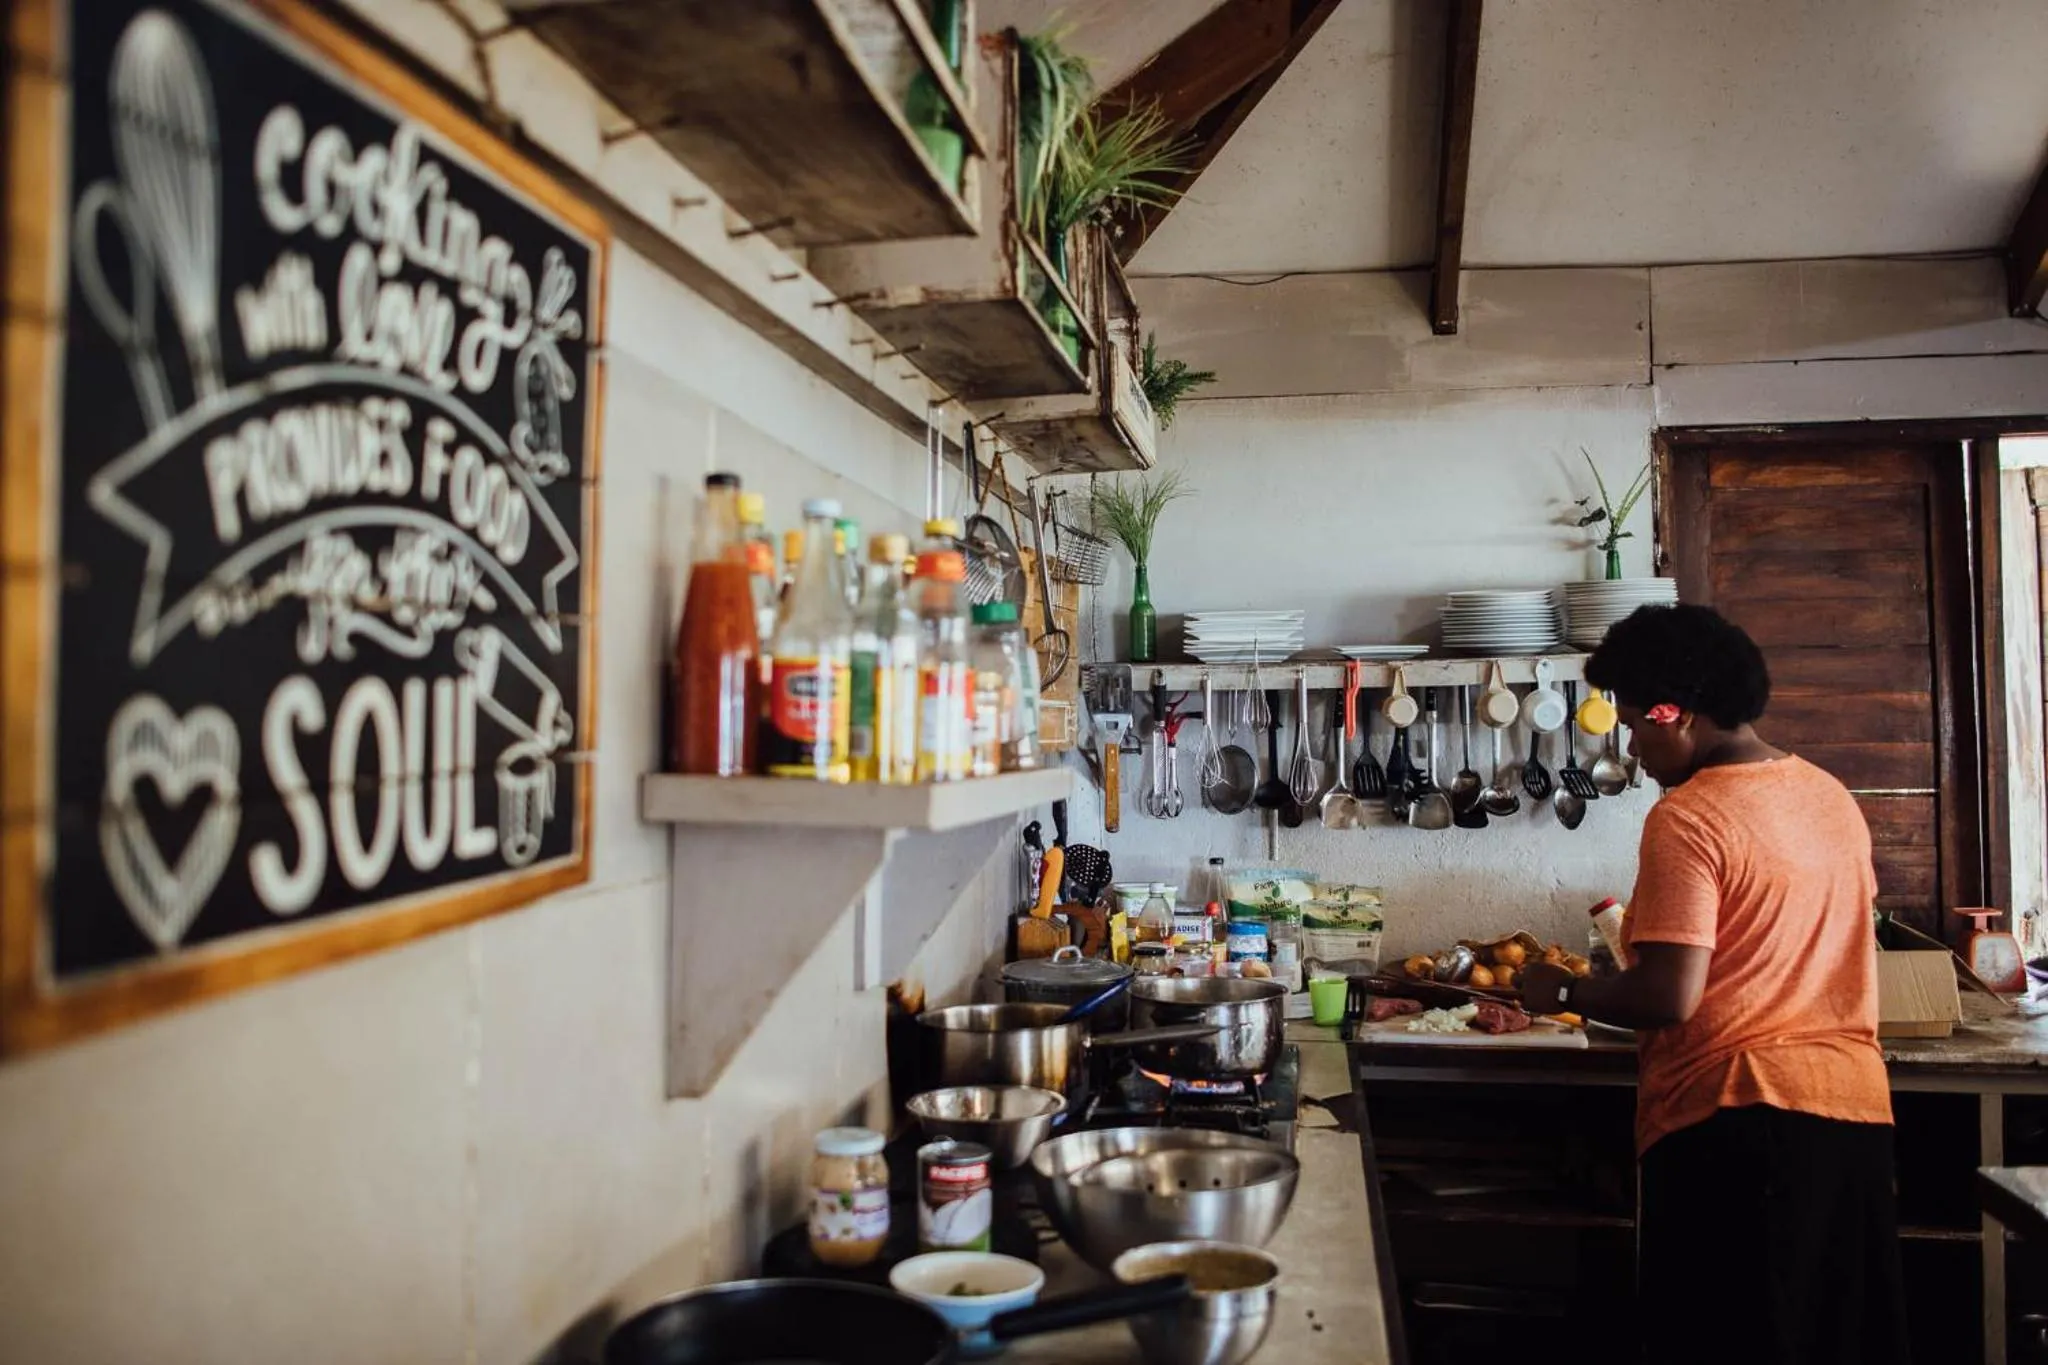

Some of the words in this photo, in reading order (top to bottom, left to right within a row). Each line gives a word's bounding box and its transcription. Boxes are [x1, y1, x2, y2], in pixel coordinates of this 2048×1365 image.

[204, 396, 413, 543] PROVIDES
[422, 417, 532, 563] FOOD
[249, 674, 498, 915] SOUL
